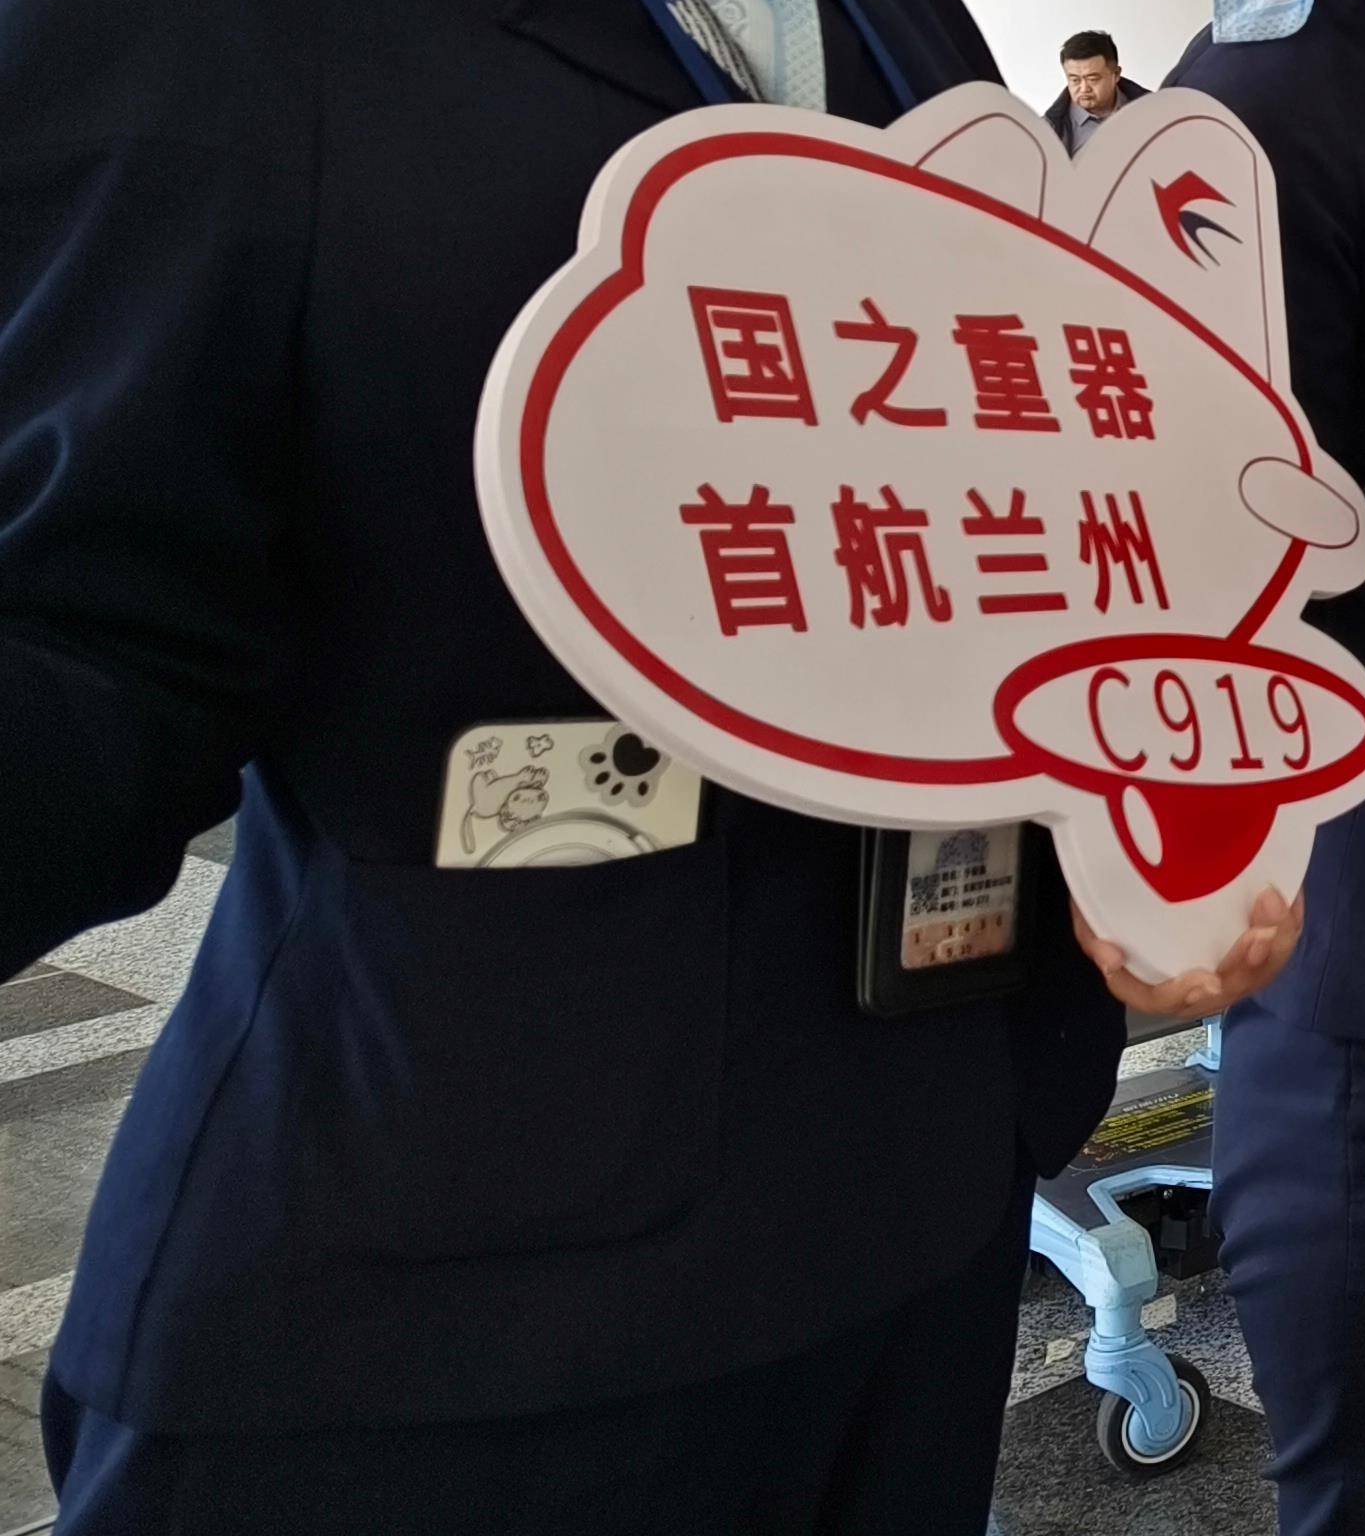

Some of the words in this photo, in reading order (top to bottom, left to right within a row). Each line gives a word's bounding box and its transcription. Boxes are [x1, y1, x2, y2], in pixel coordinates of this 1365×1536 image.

[688, 284, 1157, 442] 国之重器
[680, 484, 1171, 638] 首航兰州
[1086, 666, 1313, 774] C919
